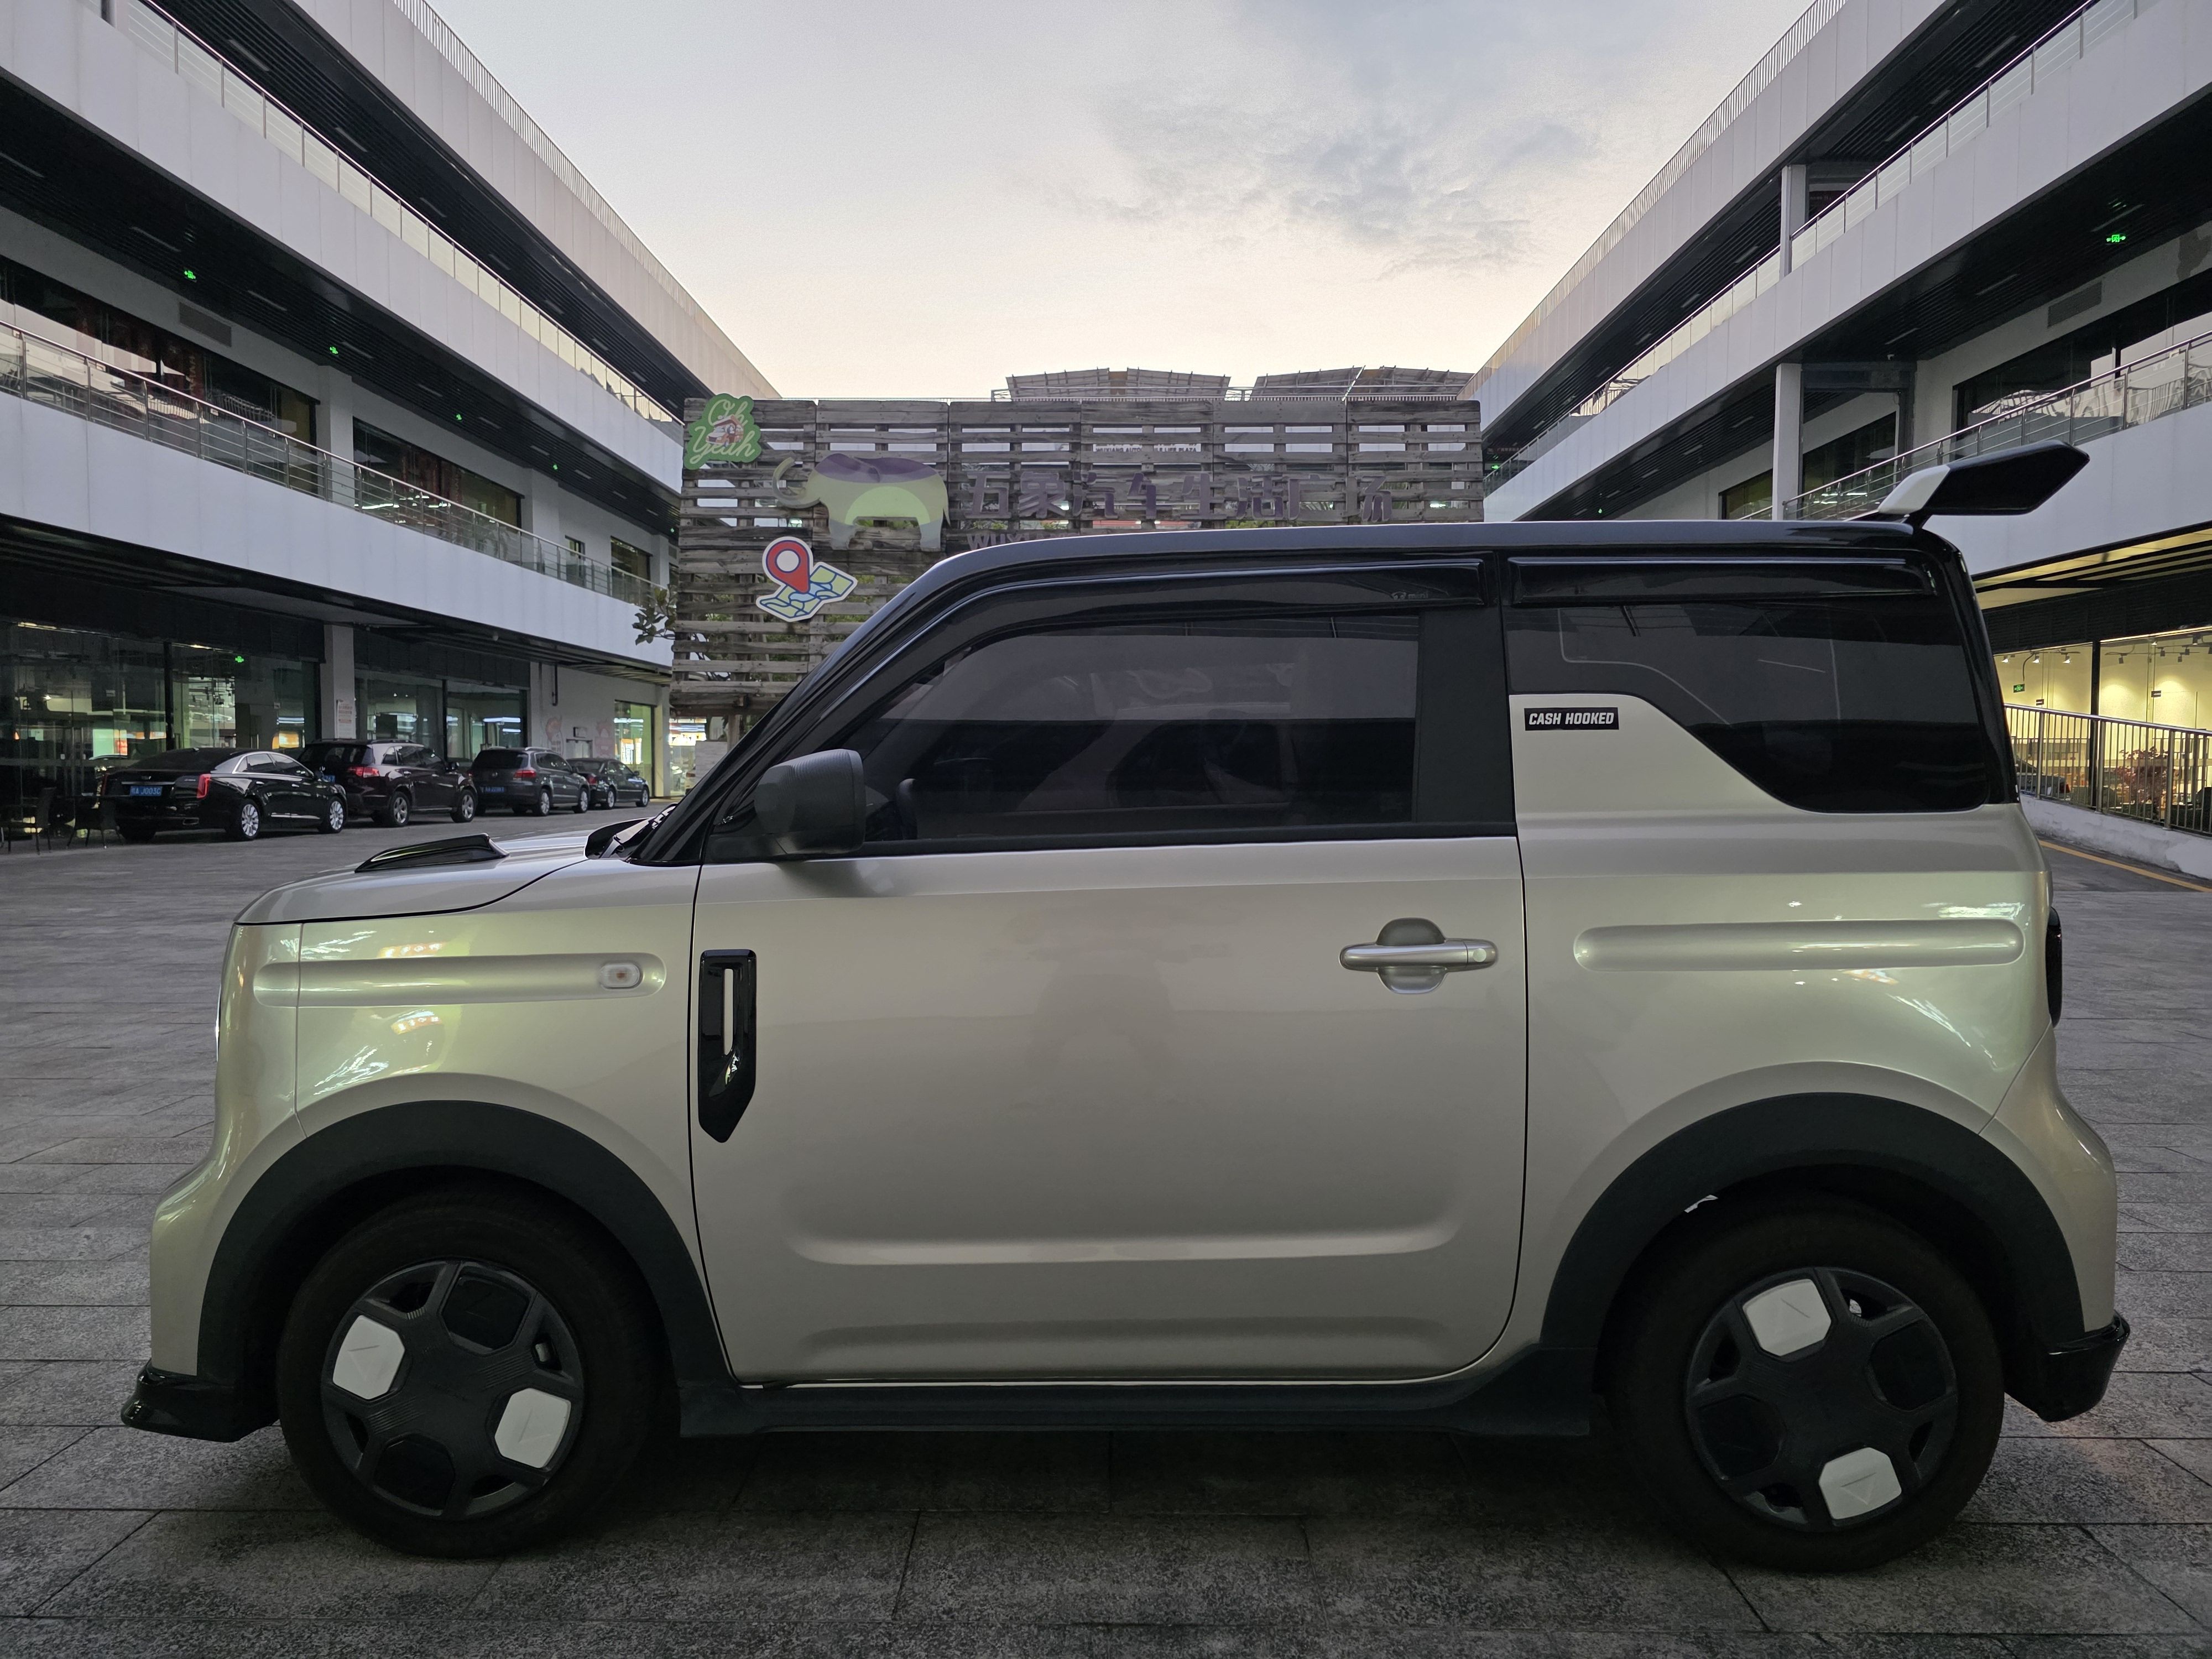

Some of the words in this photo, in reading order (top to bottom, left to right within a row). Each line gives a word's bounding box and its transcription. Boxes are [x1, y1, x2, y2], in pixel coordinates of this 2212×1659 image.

[708, 399, 748, 426] Oh
[690, 425, 755, 465] Yeah
[966, 471, 1393, 523] 五象汽车生活广场
[1528, 712, 1562, 726] CASH
[1564, 712, 1615, 725] HOOKED
